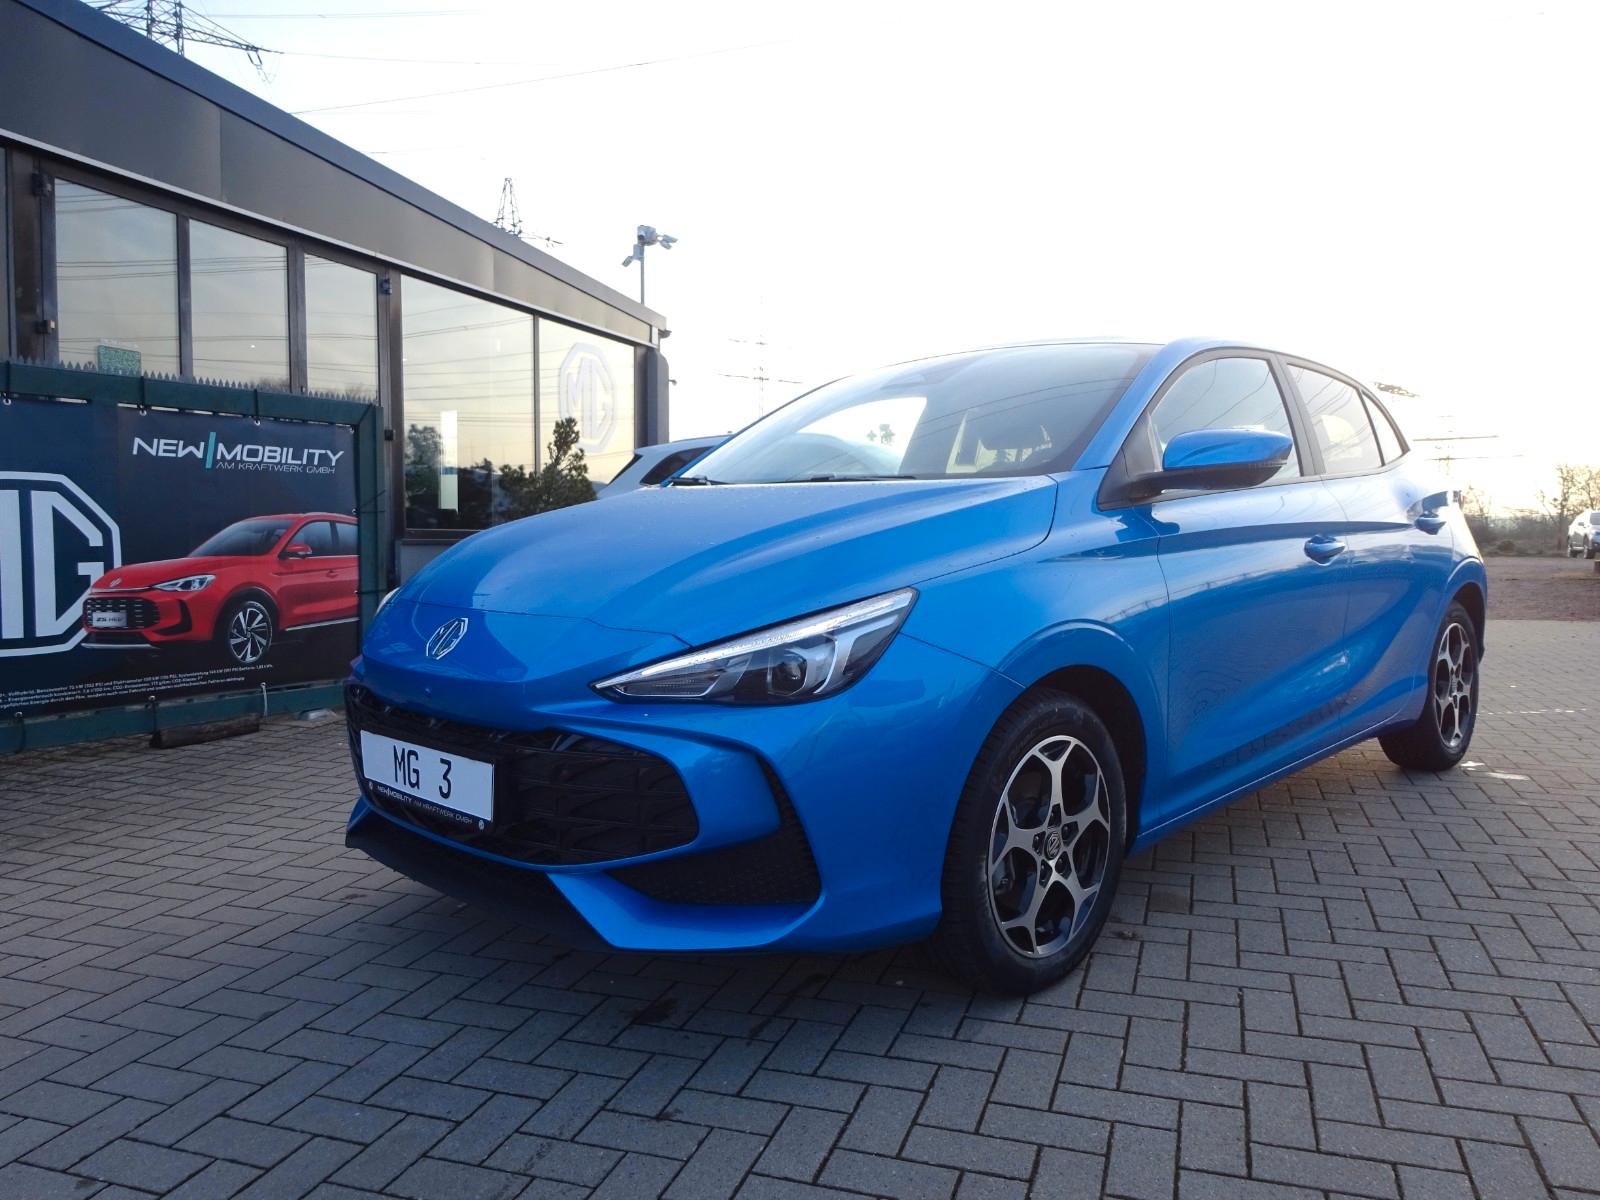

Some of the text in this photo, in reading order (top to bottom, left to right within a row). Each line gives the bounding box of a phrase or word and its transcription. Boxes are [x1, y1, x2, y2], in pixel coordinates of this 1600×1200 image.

[132, 437, 345, 466] NEW MOBILITY
[216, 461, 336, 475] AM KRAFTWERK GMBH
[393, 745, 452, 799] MG 3
